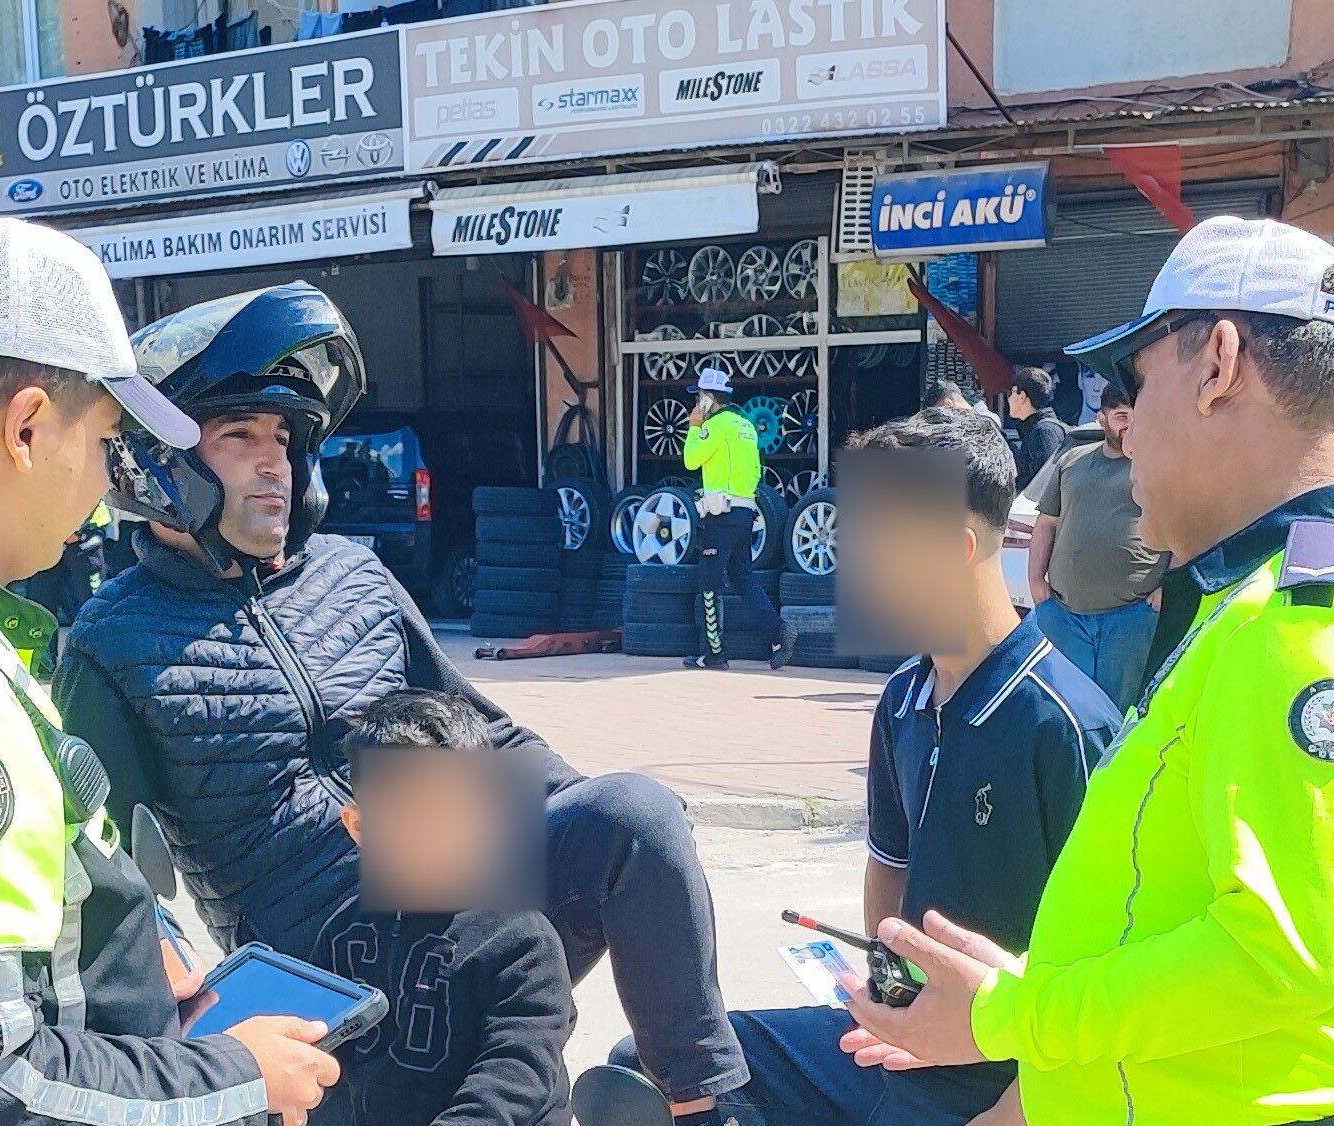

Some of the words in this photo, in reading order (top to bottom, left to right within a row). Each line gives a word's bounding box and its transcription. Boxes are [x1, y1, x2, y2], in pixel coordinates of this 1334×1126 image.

[415, 20, 565, 87] TEKİN
[583, 10, 697, 68] OTO
[834, 58, 917, 82] LASSA
[558, 86, 640, 108] starmaxx
[676, 70, 764, 102] MILESTONE
[18, 57, 377, 162] ÖZTÜRKLER
[761, 115, 813, 135] 0322
[821, 110, 859, 130] 432
[867, 108, 891, 126] 02
[900, 105, 925, 124] 55
[60, 179, 93, 200] OTO
[101, 165, 178, 197] ELEKTRİK
[186, 164, 207, 185] VE
[212, 154, 270, 183] KLİMA
[452, 205, 563, 246] MILESTONE
[878, 190, 947, 232] İNCİ
[949, 183, 1027, 227] AKÜ
[101, 235, 157, 263] KLİMA
[163, 231, 223, 257] BAKIM
[230, 222, 305, 250] ONARIM
[312, 206, 388, 242] SERVİSİ
